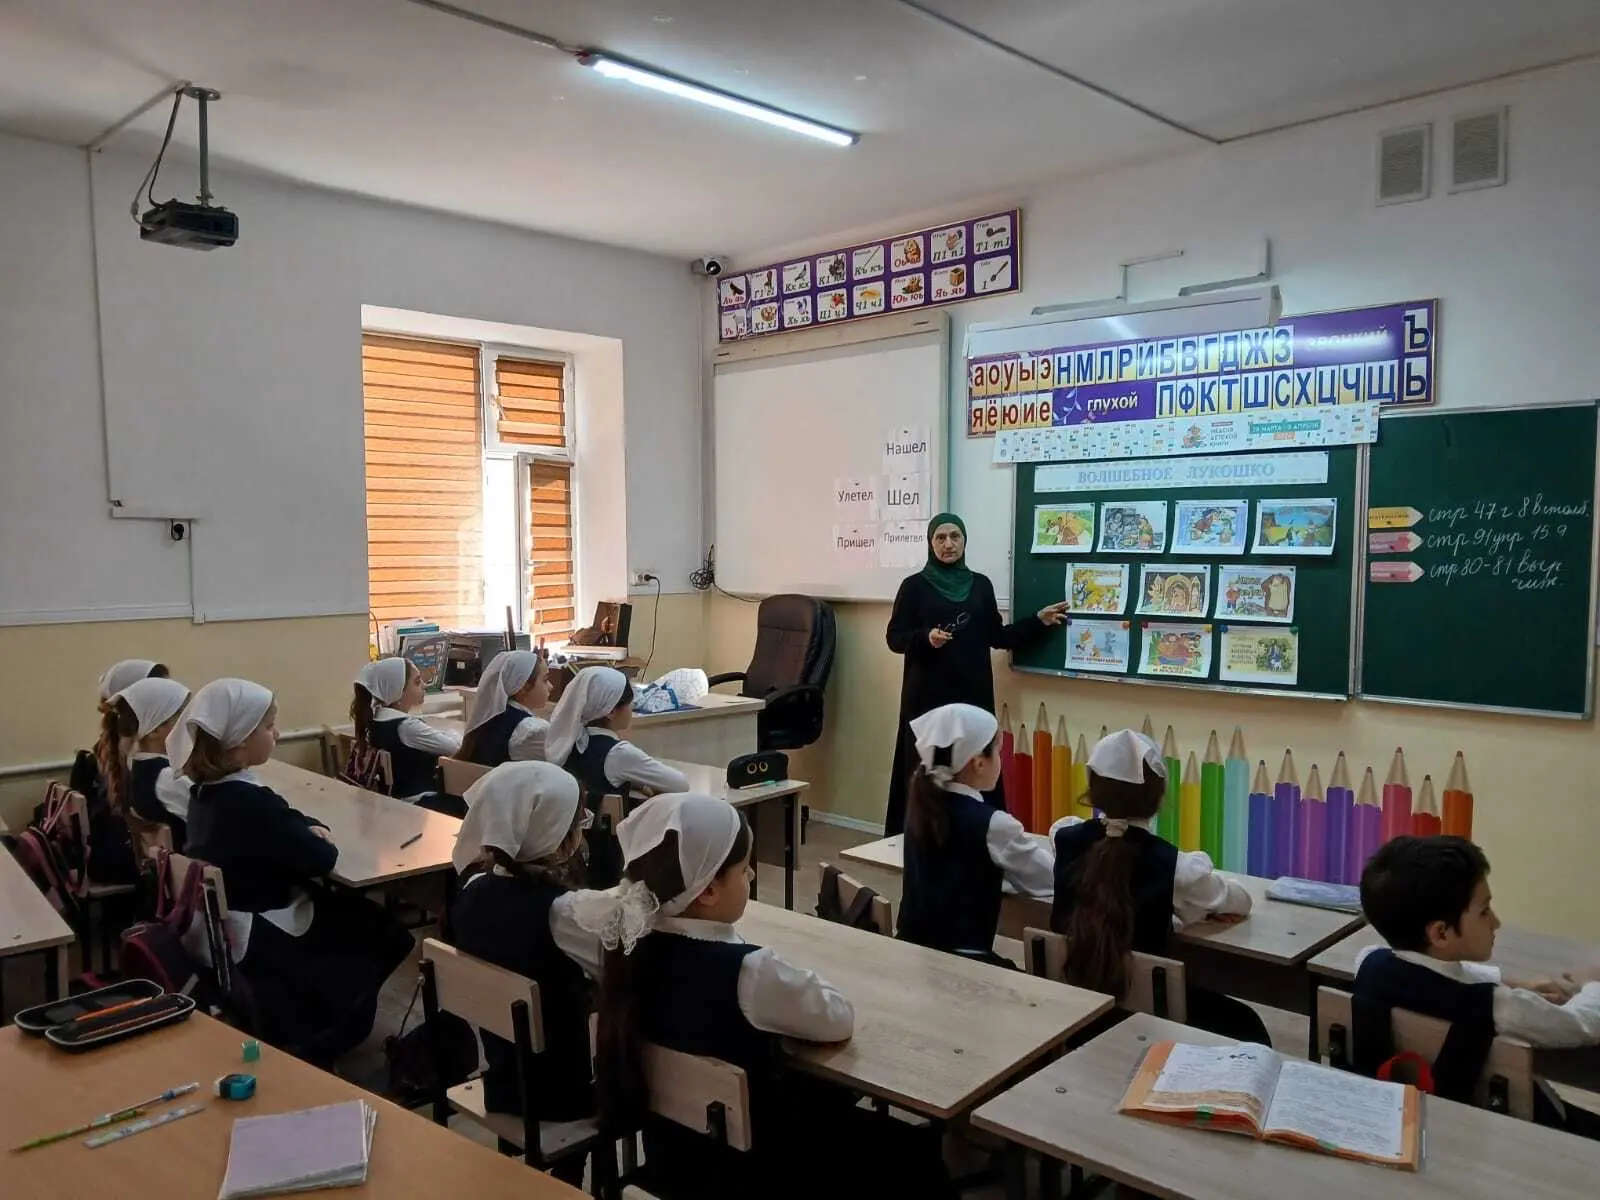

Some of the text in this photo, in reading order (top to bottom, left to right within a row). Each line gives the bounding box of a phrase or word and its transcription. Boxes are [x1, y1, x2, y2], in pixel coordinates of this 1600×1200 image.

[1086, 391, 1140, 416] глухой
[887, 441, 927, 455] Нашел
[1077, 463, 1276, 485] ВОЛШЕБНОЕ ЛУКОШКО
[838, 491, 874, 502] Улетел
[887, 490, 920, 506] Шел
[1474, 500, 1497, 520] 47
[837, 537, 875, 548] Пришел
[884, 532, 923, 543] Прилетел
